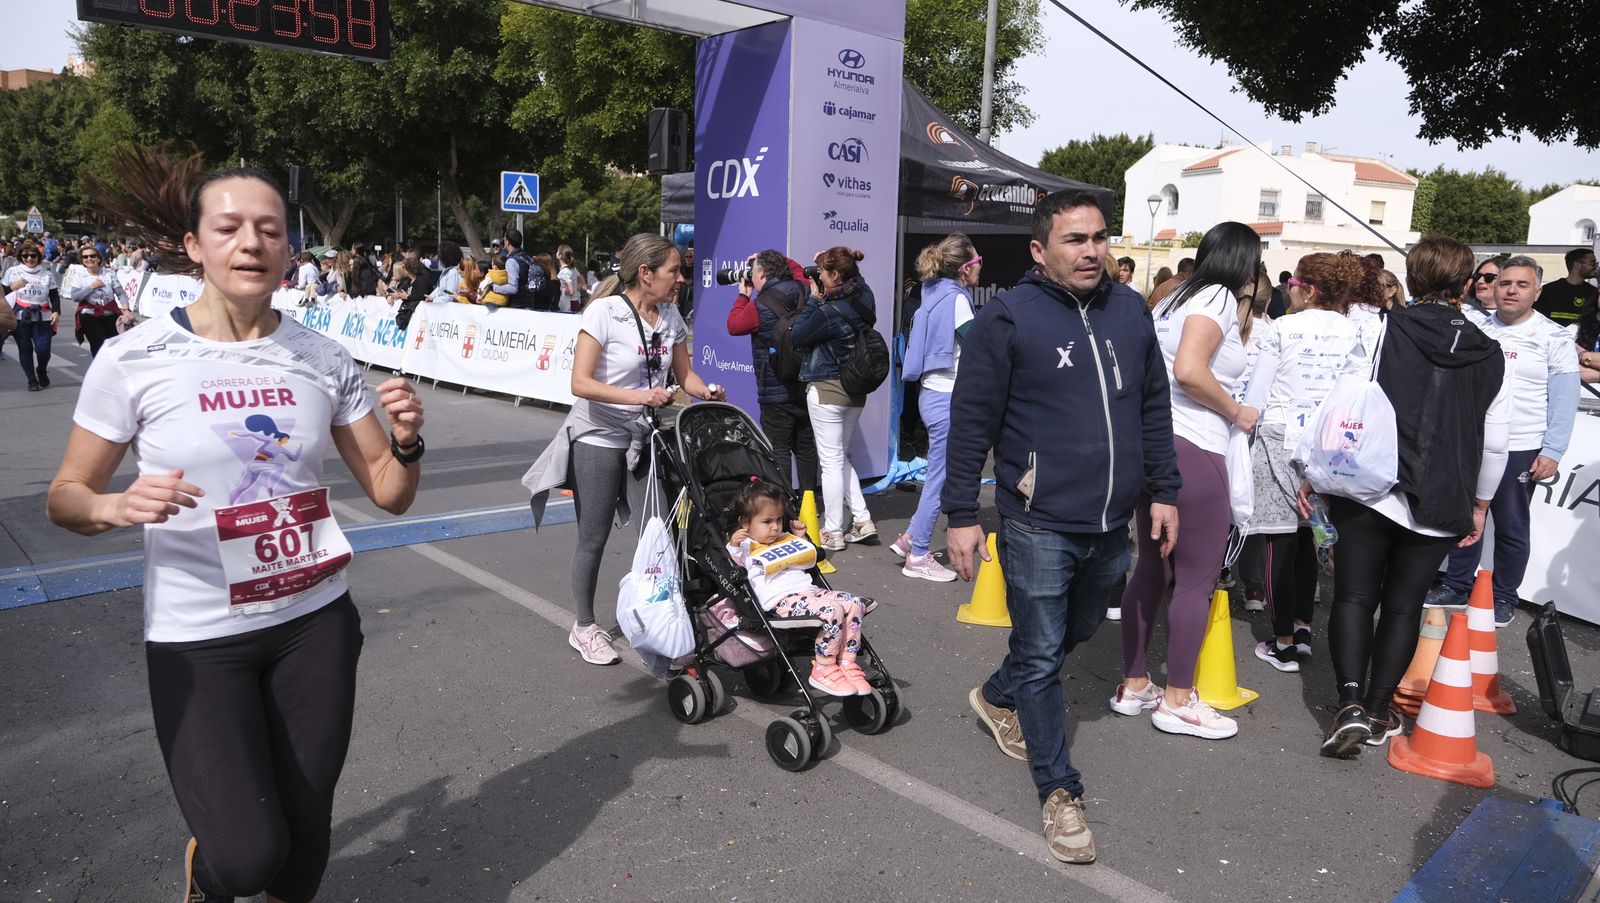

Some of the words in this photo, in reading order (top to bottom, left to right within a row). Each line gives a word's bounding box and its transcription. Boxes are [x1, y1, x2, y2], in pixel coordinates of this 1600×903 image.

[827, 67, 875, 85] HYUNDAI
[838, 106, 877, 120] cajamar
[828, 142, 862, 163] CASI
[707, 150, 765, 199] CDX
[837, 176, 872, 191] vithas
[829, 218, 869, 234] aqualia
[484, 328, 537, 352] ALMERÍA
[482, 348, 509, 362] CIUDAD
[201, 378, 254, 390] CARRERA
[255, 376, 272, 387] DE
[274, 376, 288, 385] LA
[198, 387, 297, 413] MUJER
[235, 514, 269, 527] MUJER
[254, 522, 314, 564] 607
[251, 560, 284, 576] MAITE
